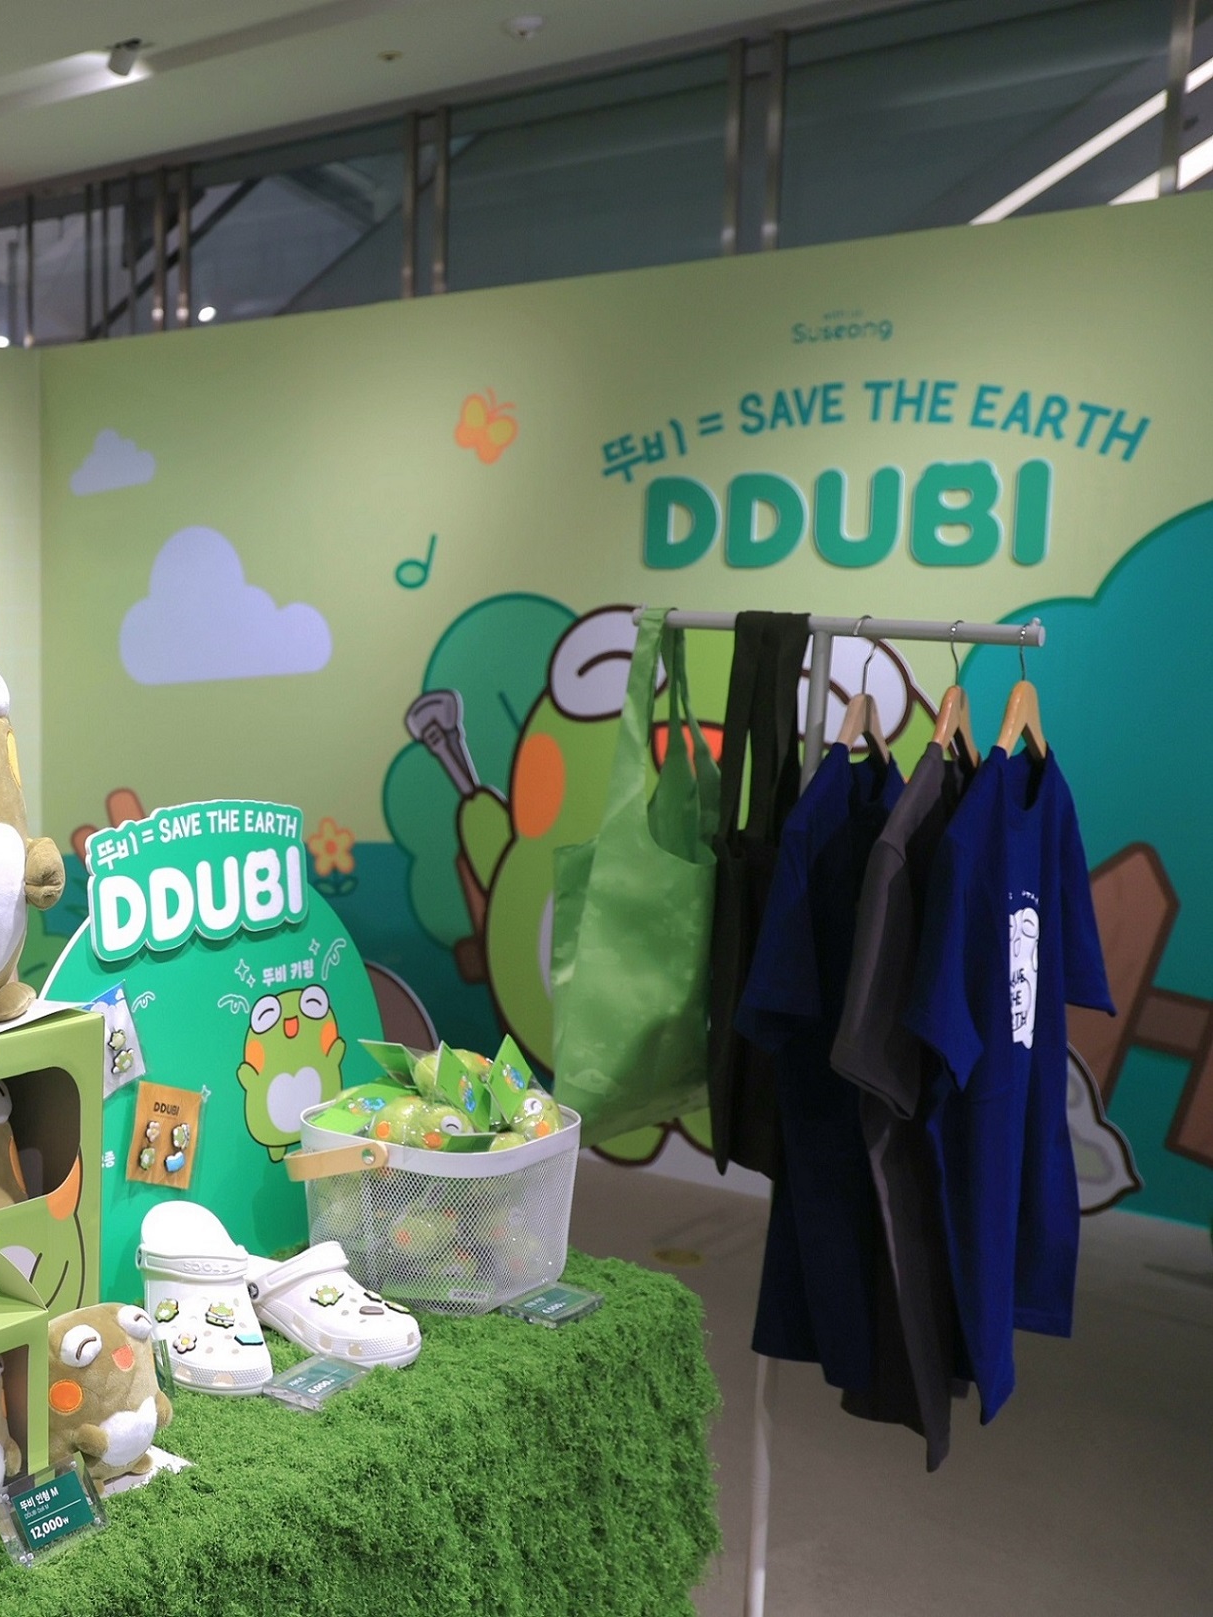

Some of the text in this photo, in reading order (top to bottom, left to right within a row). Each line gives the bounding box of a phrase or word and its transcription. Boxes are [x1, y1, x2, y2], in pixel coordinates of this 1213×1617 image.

[791, 320, 894, 344] Suseong
[738, 382, 846, 436] SAVE
[863, 378, 958, 423] THE
[969, 383, 1151, 463] EARTH
[643, 458, 1053, 570] DDUBI
[97, 831, 139, 870] 뚜비
[158, 812, 202, 844] SAVE
[206, 809, 240, 834] THE
[244, 810, 298, 839] EARTH
[98, 845, 304, 952] DDUBI
[262, 958, 314, 987] 뚜비 키링
[153, 1102, 180, 1116] DDUBI
[19, 1487, 59, 1511] 뚜비 인형 M
